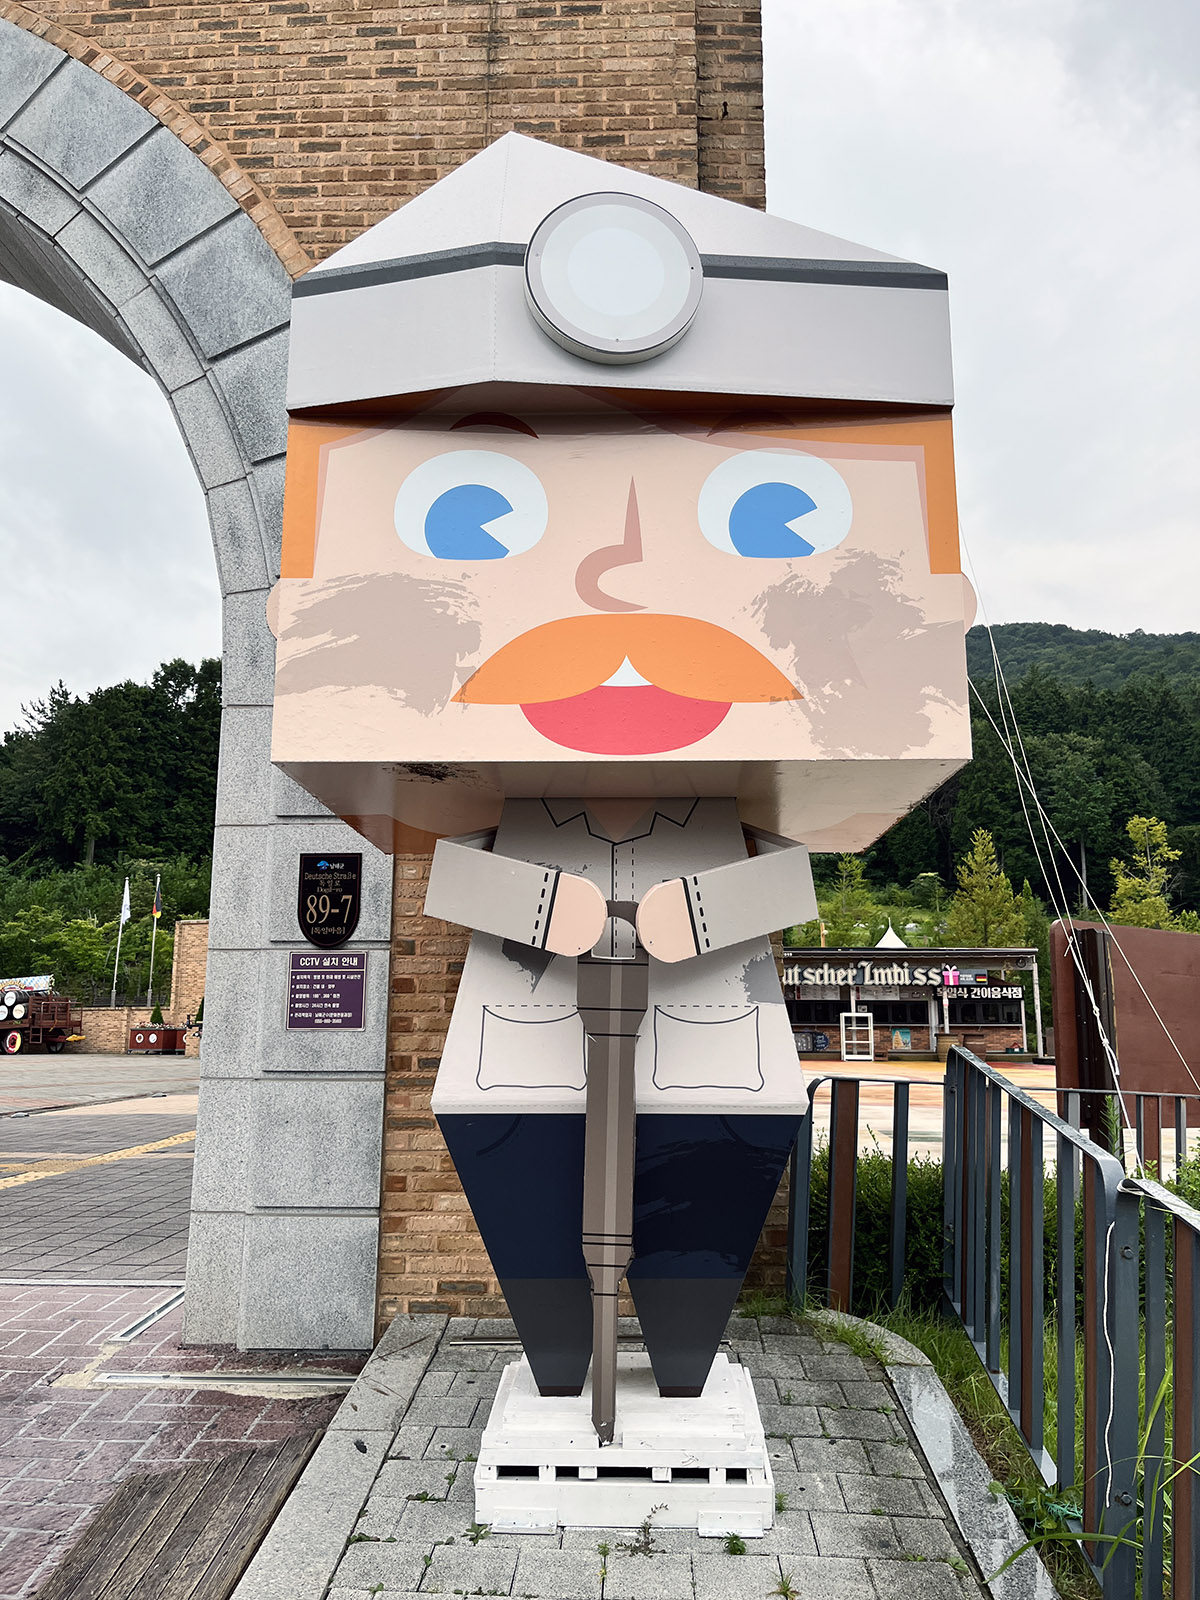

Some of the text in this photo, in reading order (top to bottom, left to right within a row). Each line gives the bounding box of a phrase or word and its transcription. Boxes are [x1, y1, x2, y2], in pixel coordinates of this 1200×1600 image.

[304, 872, 332, 880] Deutsche
[306, 894, 353, 924] 89-7
[299, 957, 358, 967] CCTV 설치 안내
[970, 986, 1023, 999] 간이음식점
